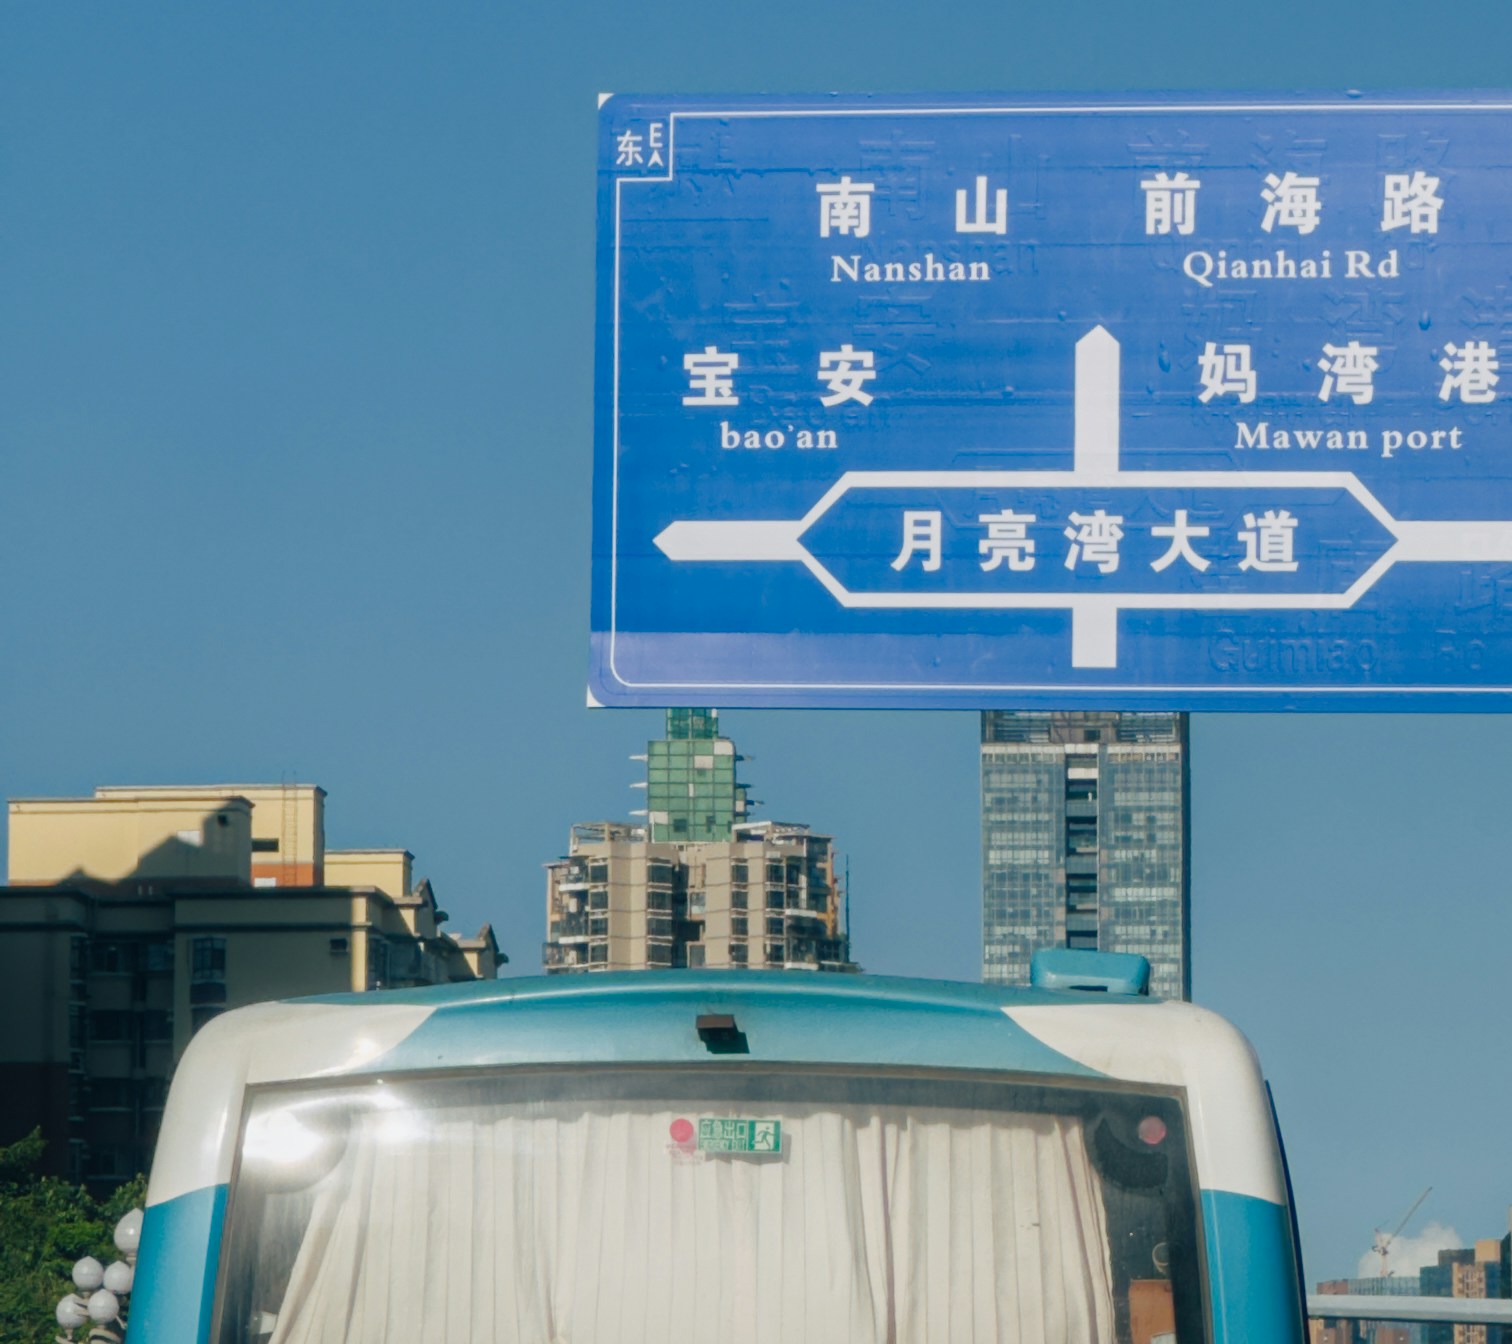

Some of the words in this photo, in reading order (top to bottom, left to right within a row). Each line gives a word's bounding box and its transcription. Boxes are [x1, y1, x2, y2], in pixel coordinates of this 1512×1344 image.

[616, 129, 643, 166] 东
[650, 123, 663, 147] E
[817, 176, 1007, 237] 南山
[1141, 171, 1443, 234] 前海路
[831, 254, 990, 281] Nanshan
[1183, 251, 1331, 286] Qianhai
[1345, 250, 1400, 278] Rd
[683, 345, 876, 407] 宝安
[1198, 341, 1500, 404] 妈湾港
[1235, 423, 1368, 449] Mawan
[1382, 426, 1462, 457] port
[891, 509, 1299, 573] 月亮湾大道
